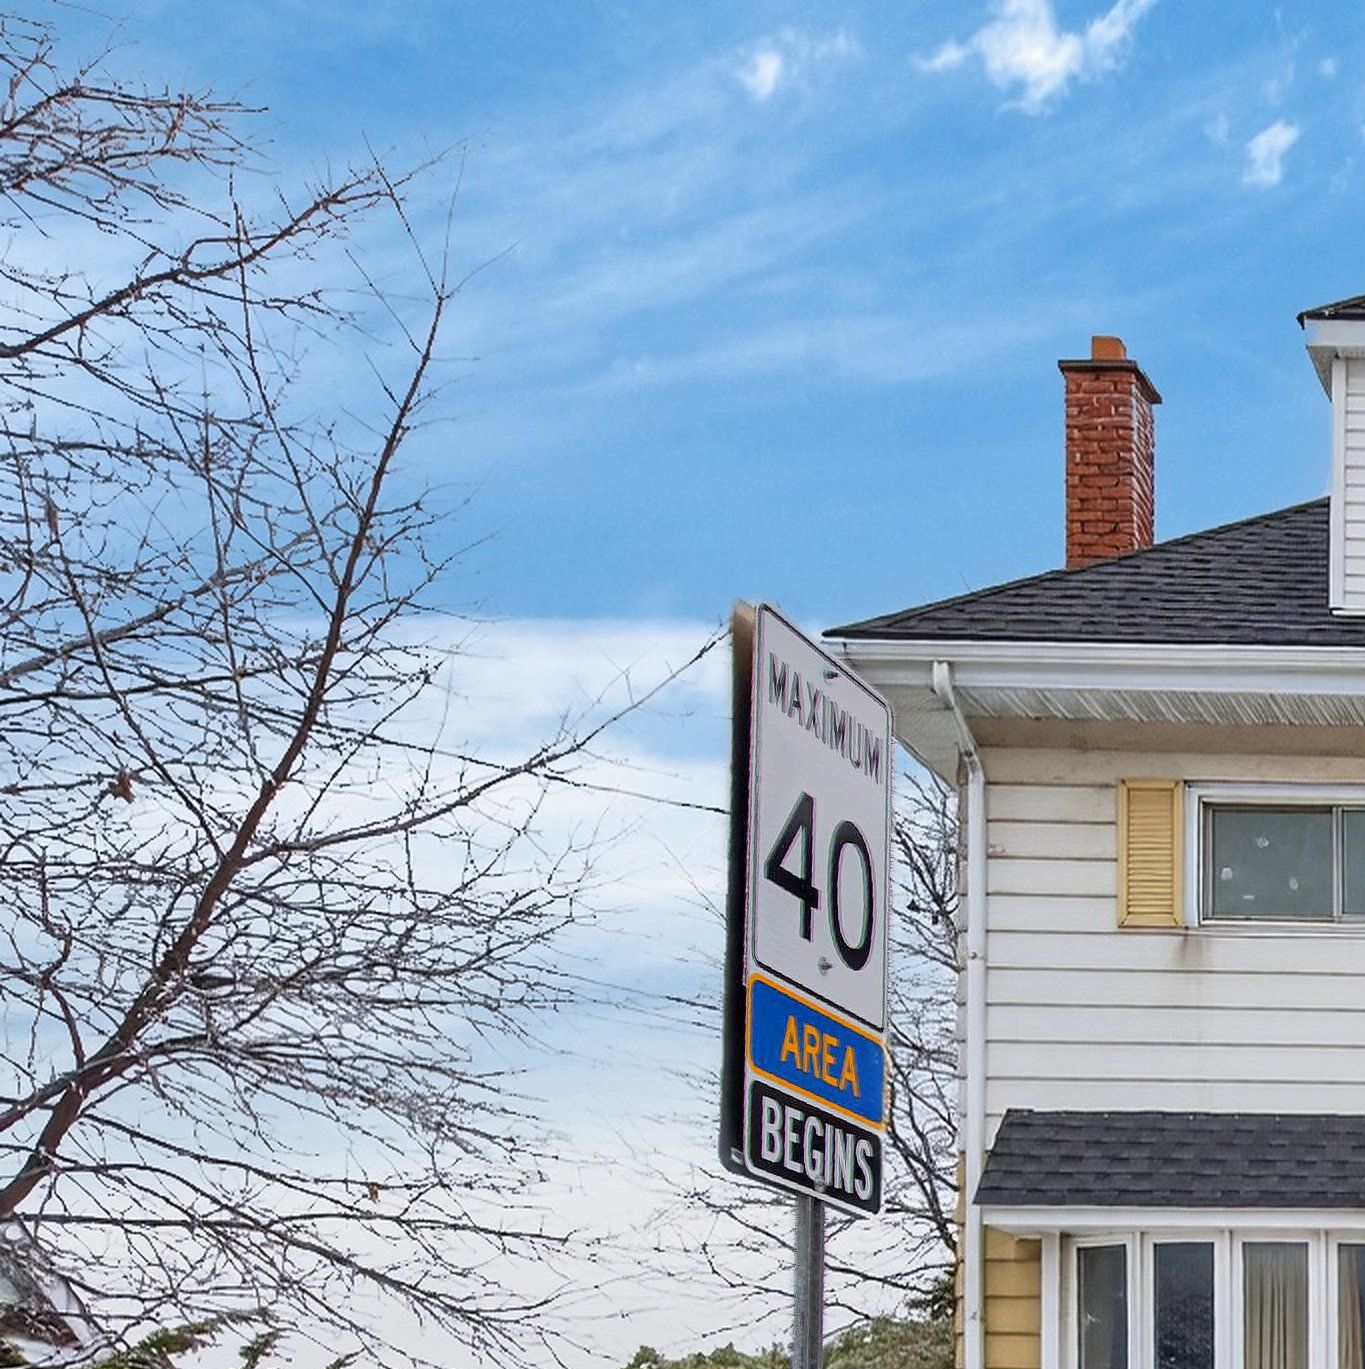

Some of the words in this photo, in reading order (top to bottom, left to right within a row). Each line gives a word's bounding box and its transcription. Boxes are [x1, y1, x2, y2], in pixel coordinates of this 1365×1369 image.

[768, 652, 882, 784] MAXIMUM
[764, 790, 875, 971] 40
[780, 1015, 860, 1097] AREA
[761, 1096, 874, 1200] BEGINS
